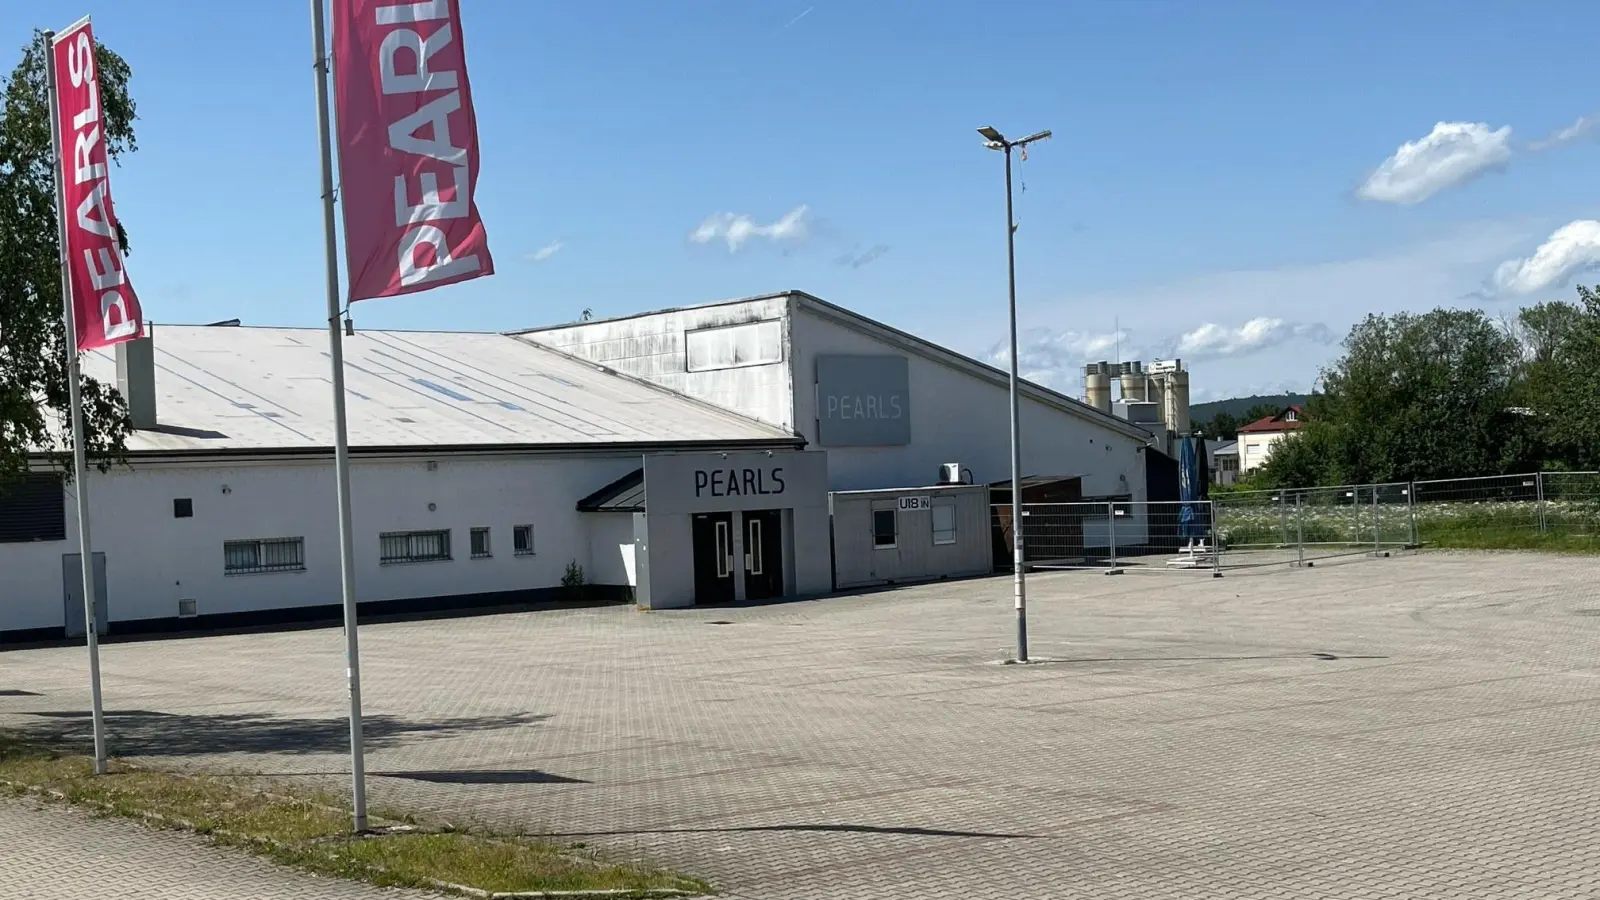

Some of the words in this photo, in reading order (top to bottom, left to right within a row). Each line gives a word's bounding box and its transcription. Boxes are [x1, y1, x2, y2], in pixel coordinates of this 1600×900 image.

[68, 31, 138, 341] PEARLS
[827, 394, 902, 420] PEARLS
[695, 467, 786, 497] PEARLS
[899, 497, 919, 509] U18
